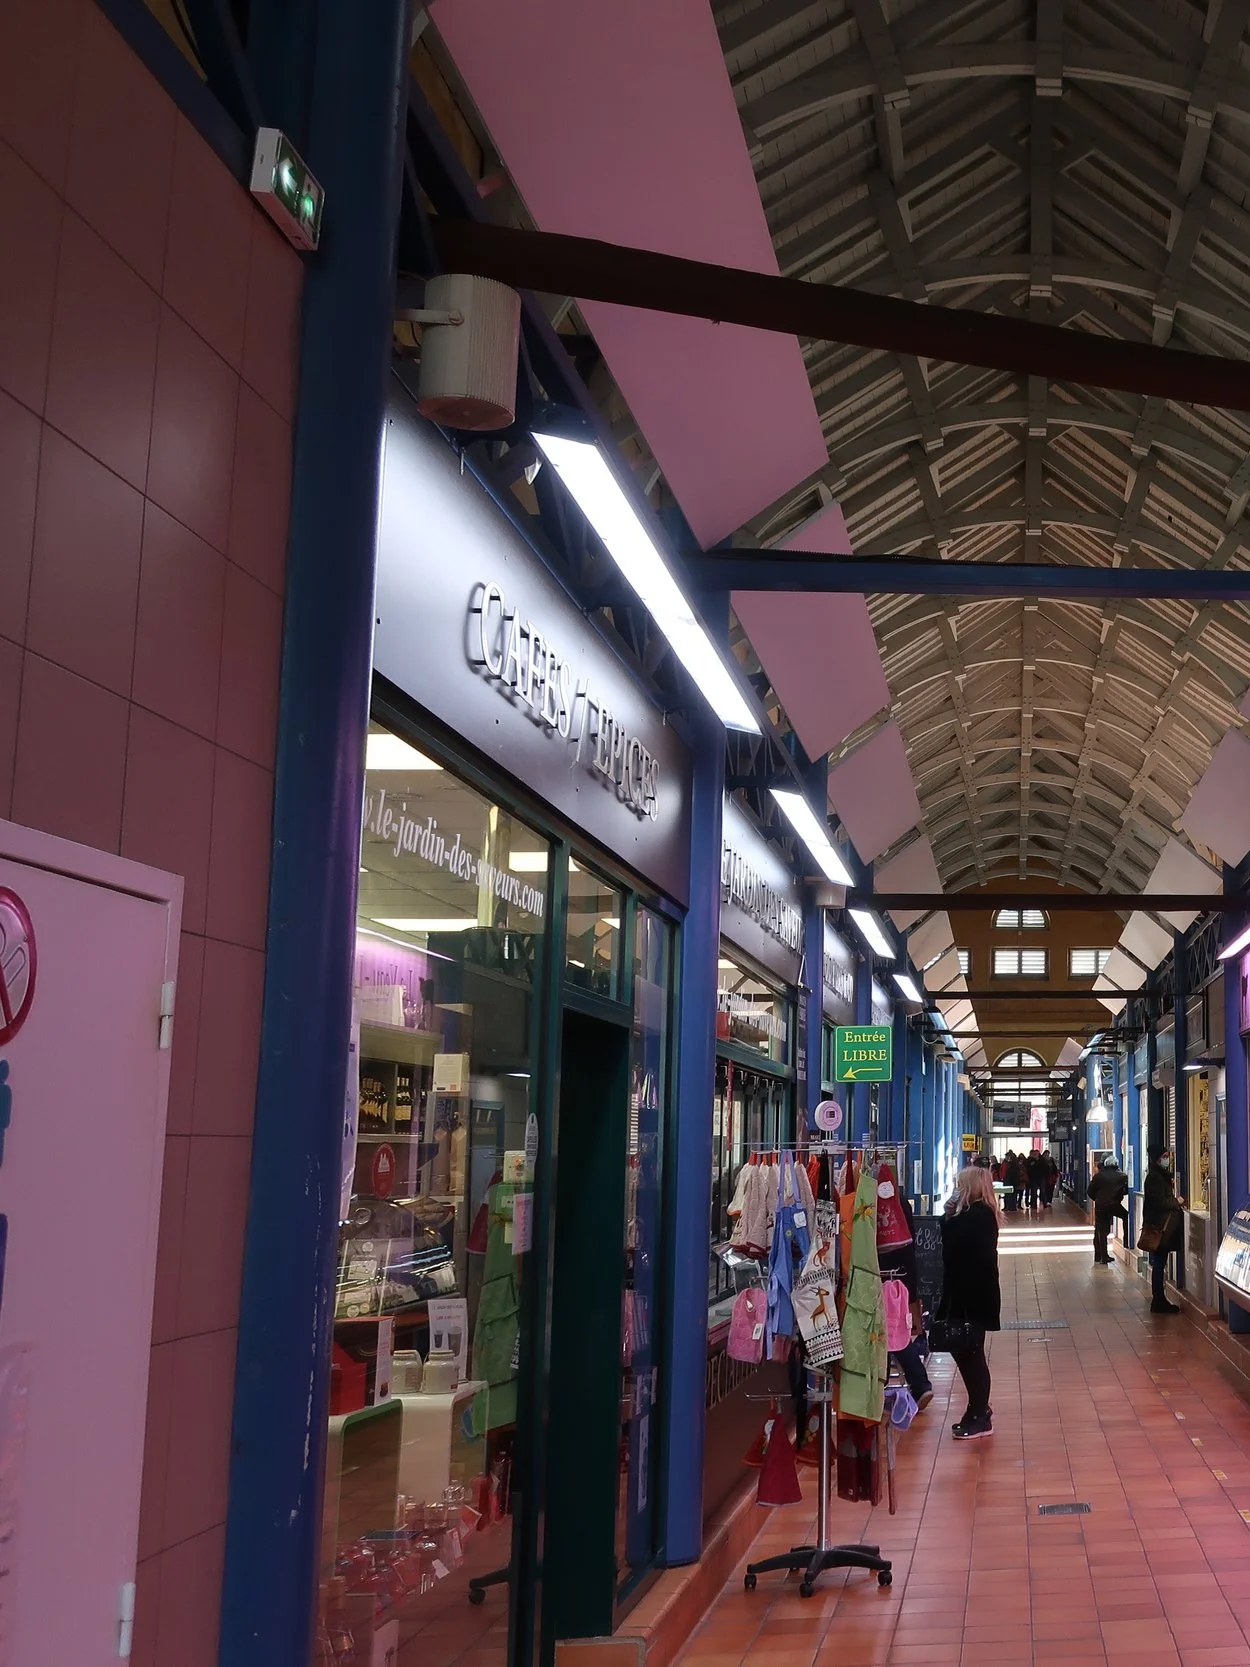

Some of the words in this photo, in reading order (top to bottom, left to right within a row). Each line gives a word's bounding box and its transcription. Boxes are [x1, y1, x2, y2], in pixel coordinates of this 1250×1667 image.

[481, 580, 571, 738] CAFES
[593, 697, 660, 822] EPICES
[844, 1031, 886, 1042] Entrée
[843, 1050, 887, 1061] LIBRE
